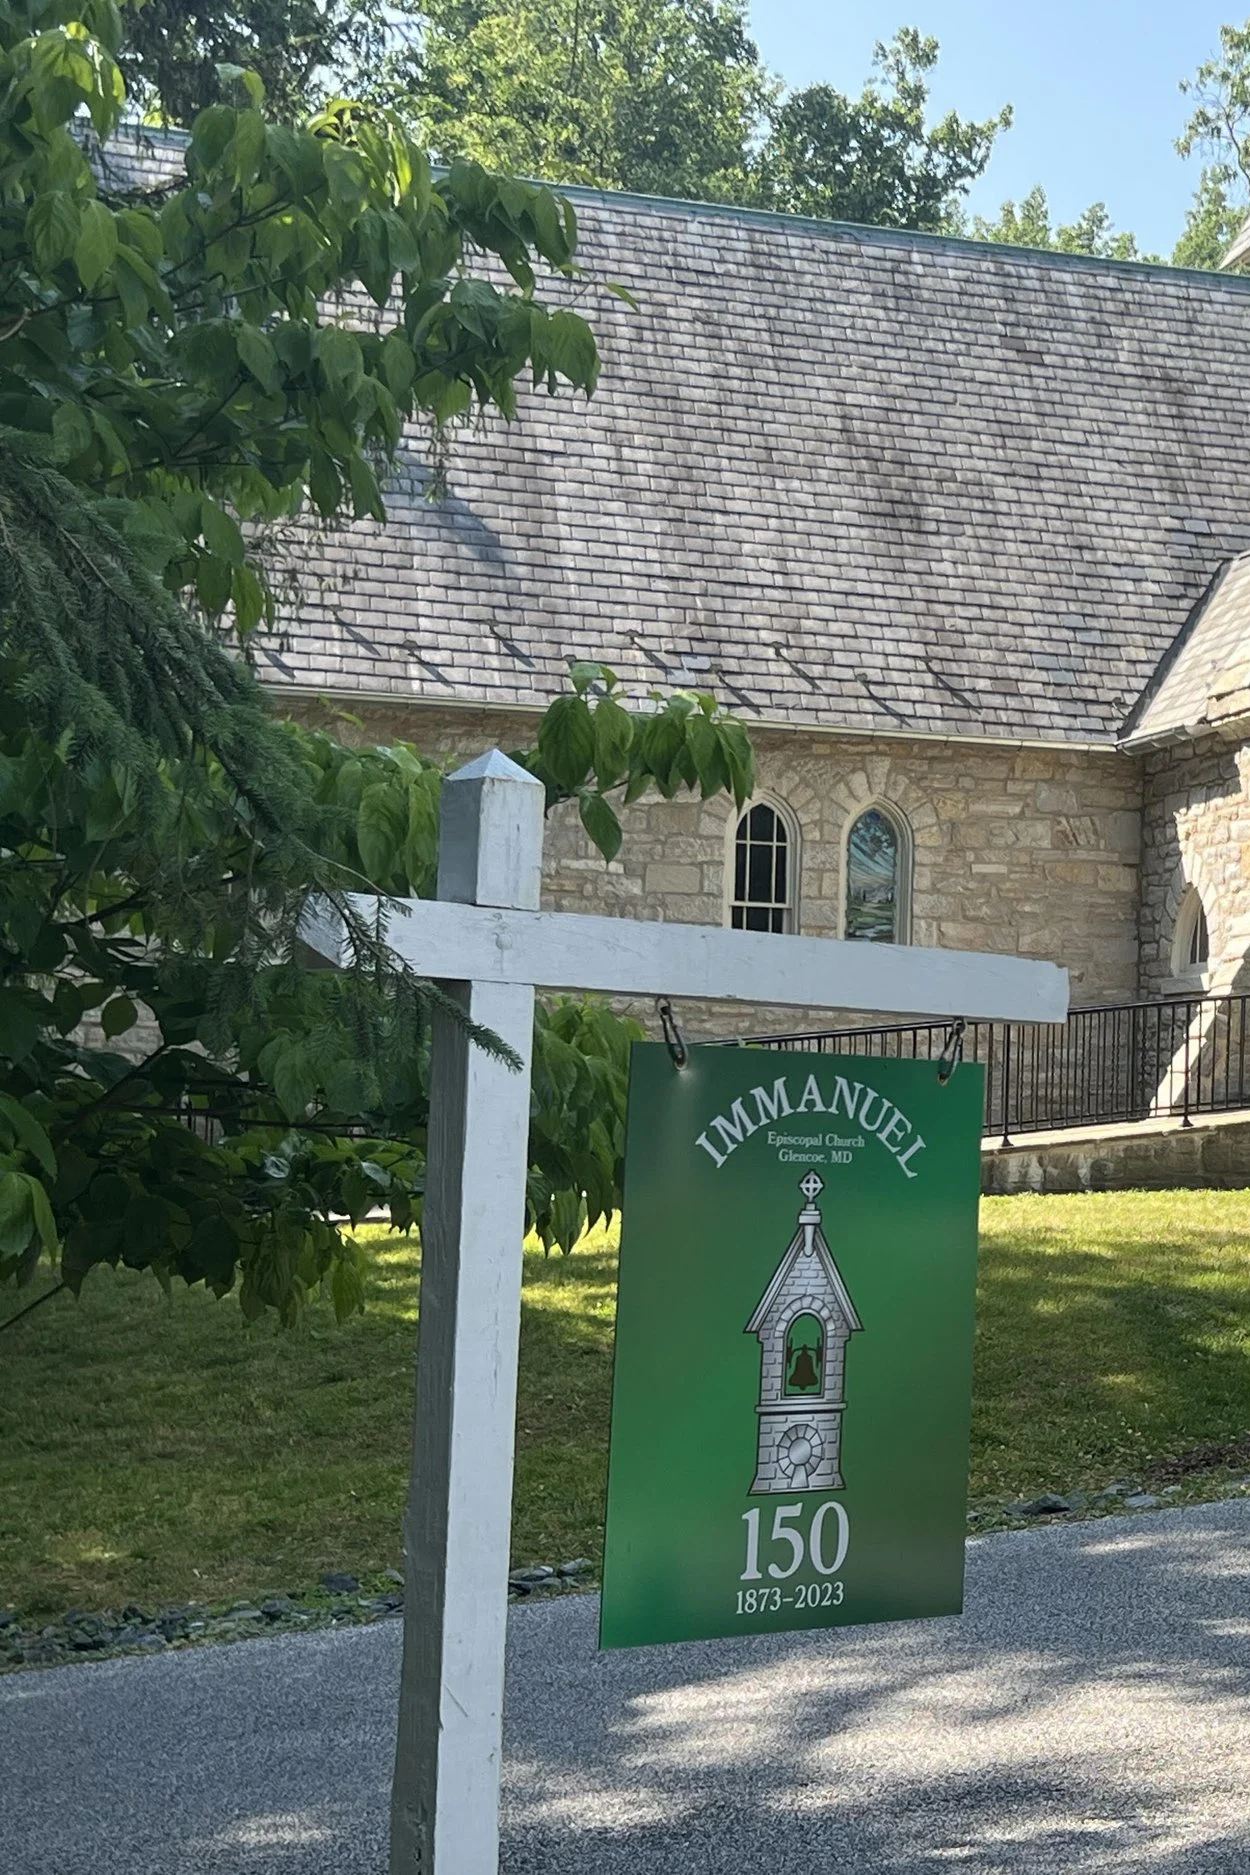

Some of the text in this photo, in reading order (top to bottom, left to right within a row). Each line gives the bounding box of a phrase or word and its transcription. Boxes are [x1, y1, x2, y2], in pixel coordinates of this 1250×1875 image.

[695, 1074, 926, 1178] IMMANUEL
[767, 1131, 865, 1148] Episcopal Church
[778, 1150, 853, 1164] Glencoe, MD
[740, 1501, 849, 1580] 150
[736, 1581, 844, 1614] 1873–2023
